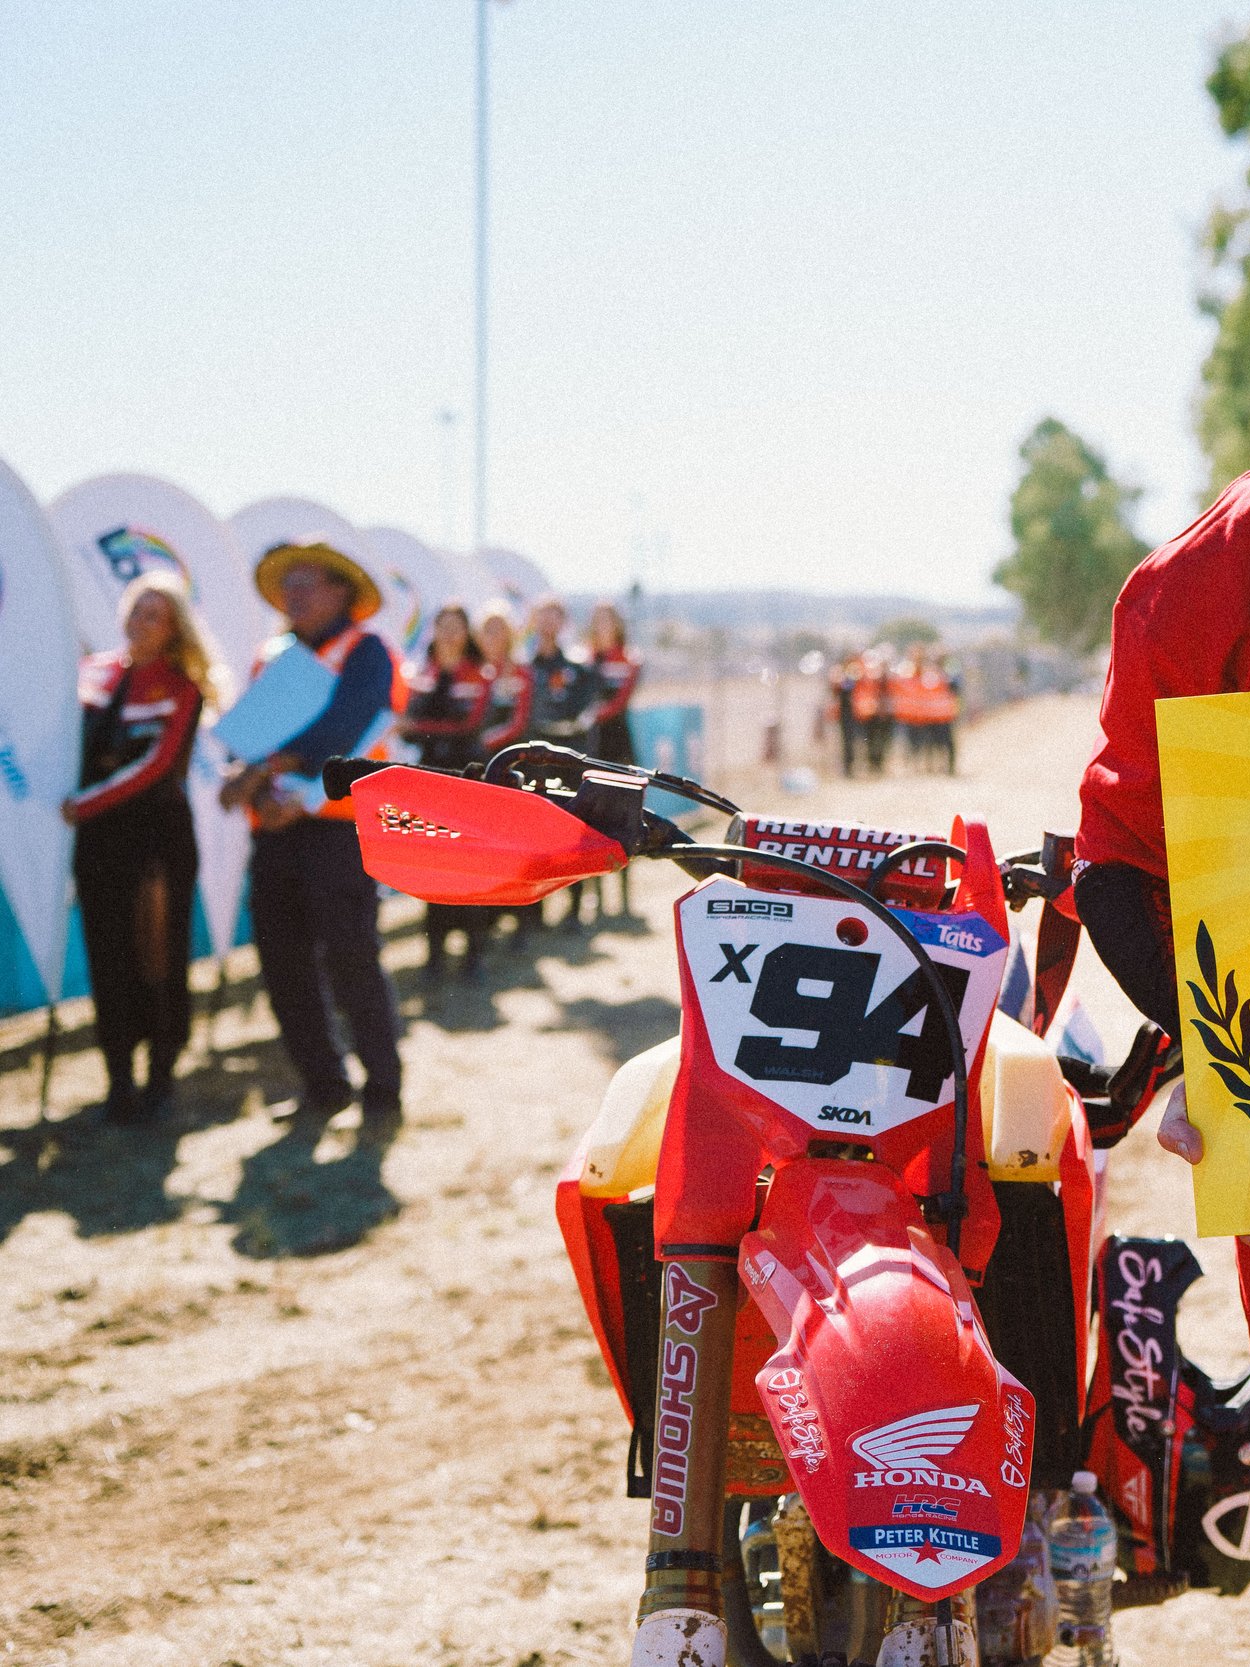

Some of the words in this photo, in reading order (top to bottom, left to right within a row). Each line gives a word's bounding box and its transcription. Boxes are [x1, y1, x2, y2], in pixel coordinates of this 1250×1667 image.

[755, 820, 922, 846] RENTHA
[757, 841, 936, 877] RENTHL
[712, 900, 789, 917] shop
[937, 924, 984, 952] Tatts
[734, 943, 972, 1102] 94
[817, 1105, 872, 1126] SKDA
[652, 1338, 698, 1537] SHOWA
[854, 1469, 992, 1498] HONDA
[892, 1493, 962, 1517] HRC
[874, 1528, 925, 1545] PETER
[928, 1527, 980, 1551] KITTLE
[875, 1551, 914, 1560] MOTOR
[939, 1553, 979, 1565] COMPANY
